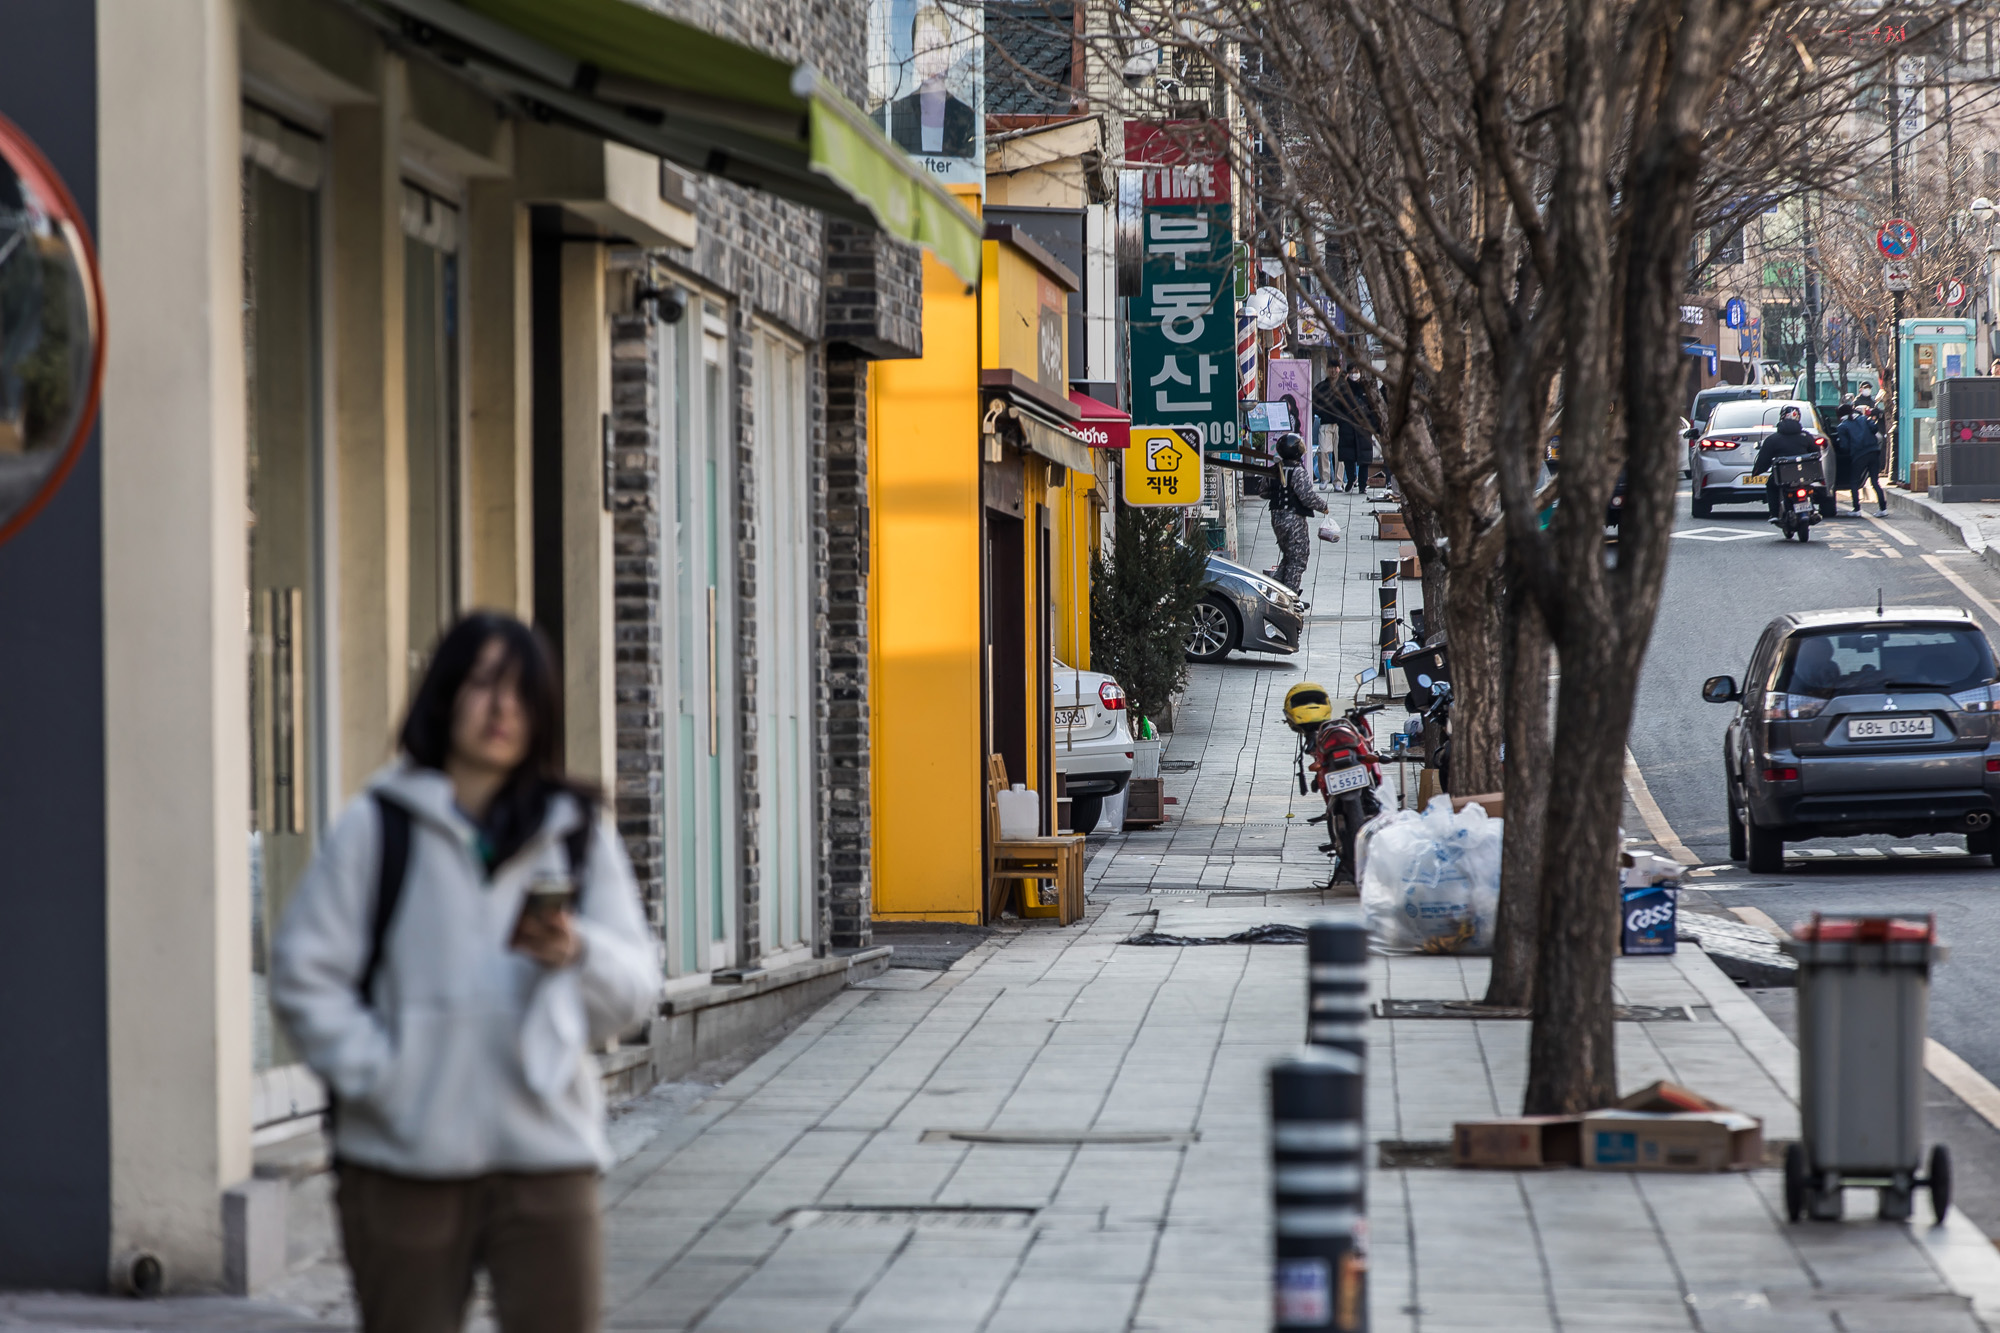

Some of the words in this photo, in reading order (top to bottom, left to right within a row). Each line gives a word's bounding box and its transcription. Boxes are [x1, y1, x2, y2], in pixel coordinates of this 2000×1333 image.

[1143, 165, 1215, 198] TIME
[1149, 213, 1219, 412] 부동산
[1679, 305, 1704, 325] OFFEE
[1146, 475, 1178, 495] 직방
[1890, 720, 1926, 733] 0364
[1339, 775, 1363, 788] 5527
[1626, 901, 1673, 932] Cass
